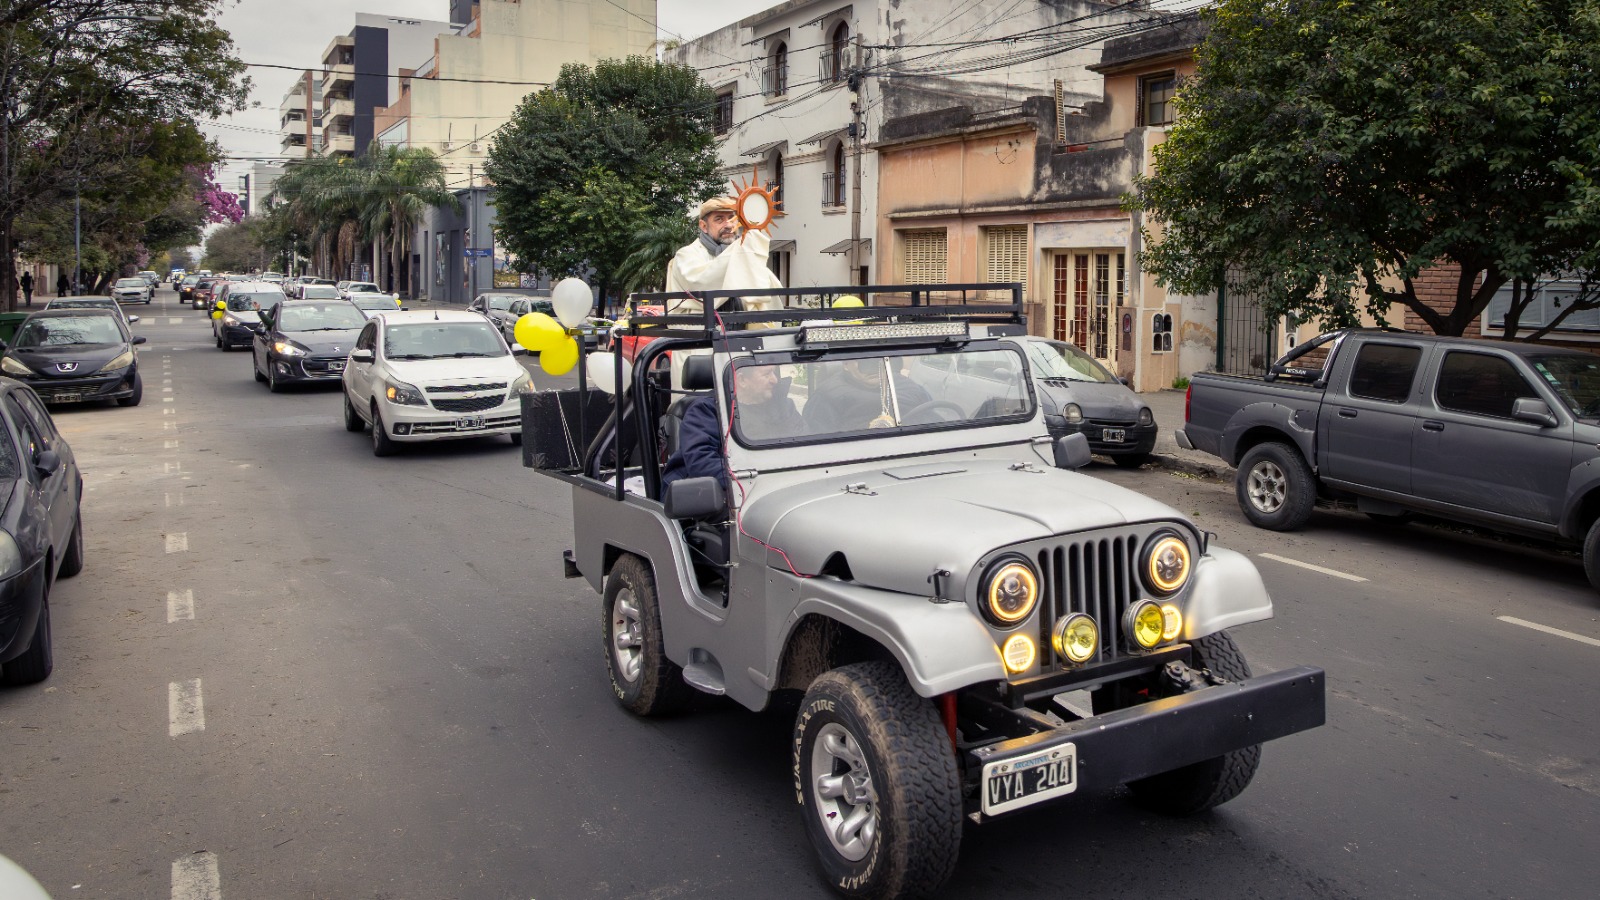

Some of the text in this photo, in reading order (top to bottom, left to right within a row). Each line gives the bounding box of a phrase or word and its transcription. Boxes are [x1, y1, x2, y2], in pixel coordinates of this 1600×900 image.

[794, 699, 836, 806] SUMAXX TIRE
[990, 758, 1070, 804] VYA 244
